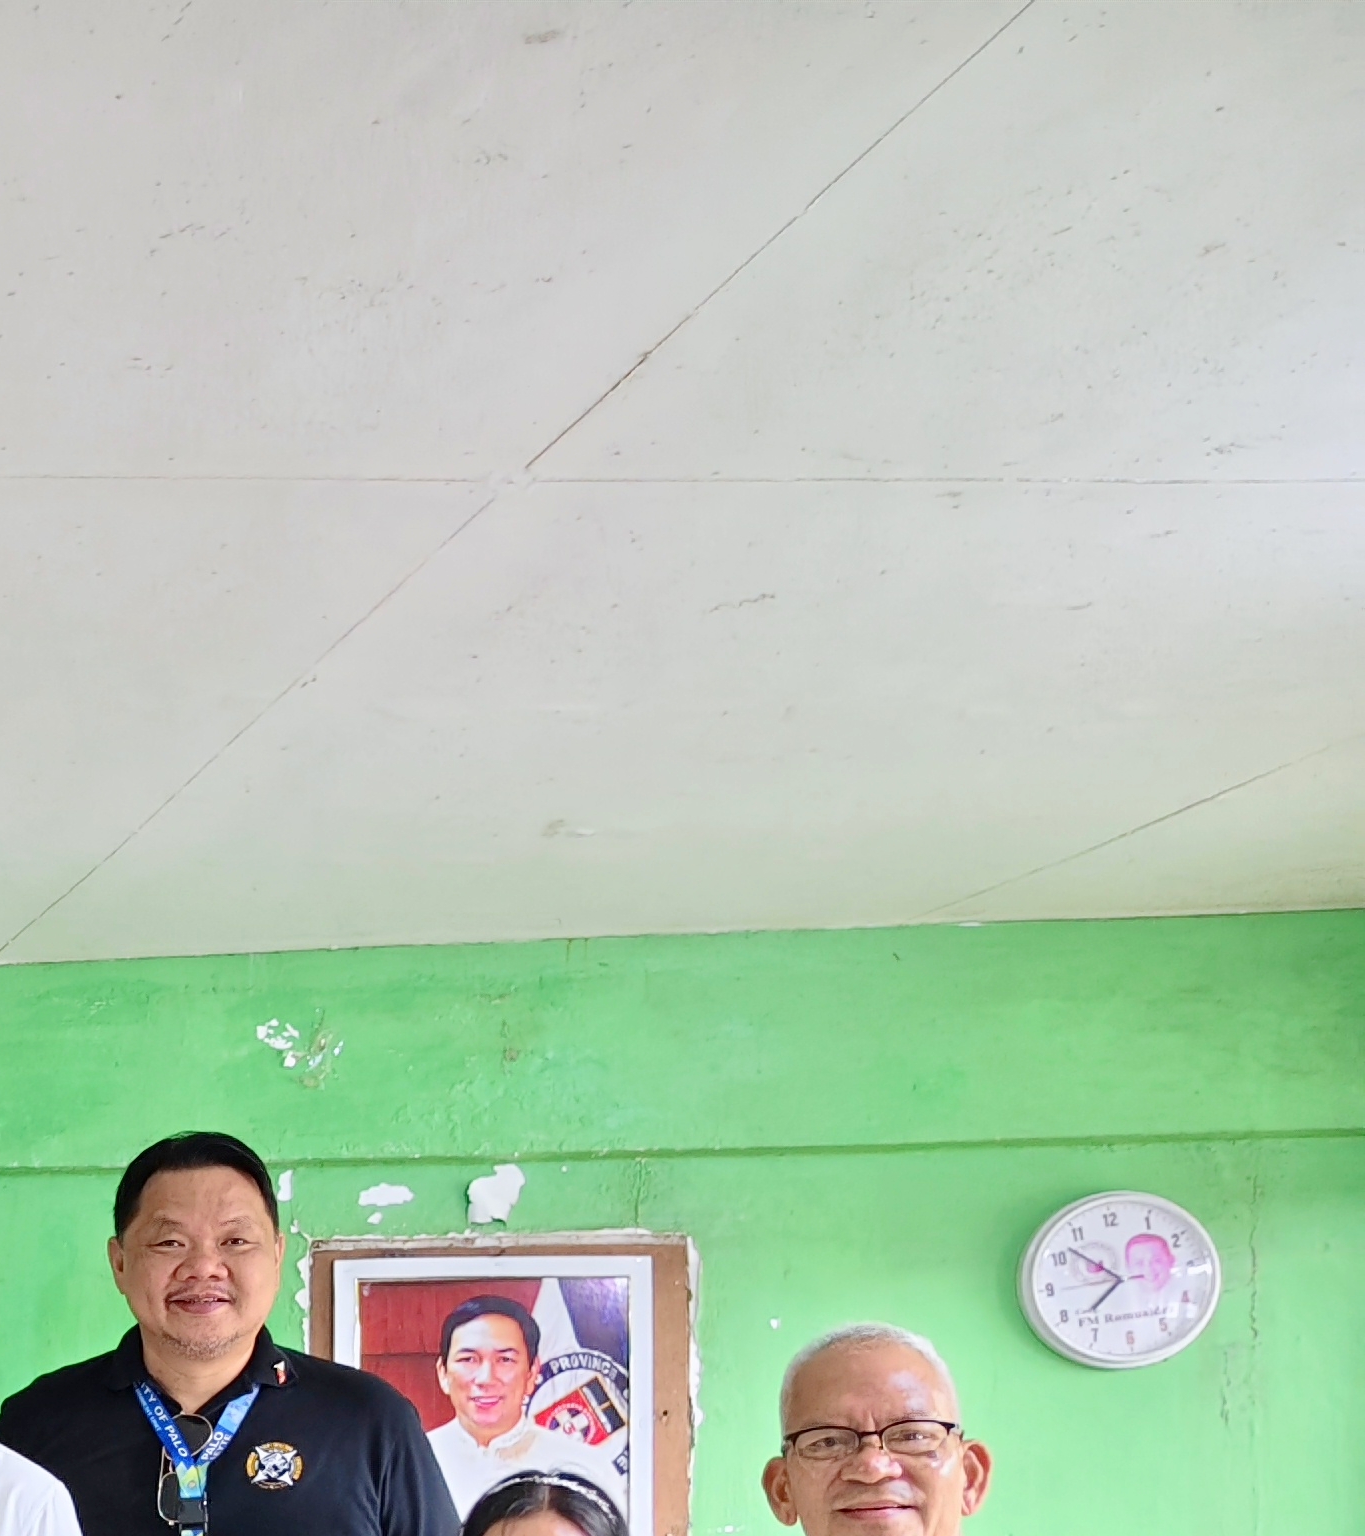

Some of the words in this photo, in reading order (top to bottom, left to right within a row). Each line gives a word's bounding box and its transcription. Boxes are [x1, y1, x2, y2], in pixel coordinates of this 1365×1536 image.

[1103, 1213, 1118, 1228] 12
[1144, 1215, 1151, 1230] 1
[1071, 1226, 1084, 1242] 11
[1171, 1233, 1181, 1248] 2
[1052, 1251, 1068, 1266] 10
[1045, 1282, 1054, 1297] 9
[1181, 1290, 1190, 1303] 4
[1060, 1309, 1069, 1323] 8
[1159, 1317, 1168, 1332] 5
[1090, 1327, 1099, 1343] 7
[1126, 1330, 1135, 1345] 6
[154, 1405, 169, 1423] OF
[165, 1425, 188, 1458] PALO
[200, 1431, 224, 1461] PALO
